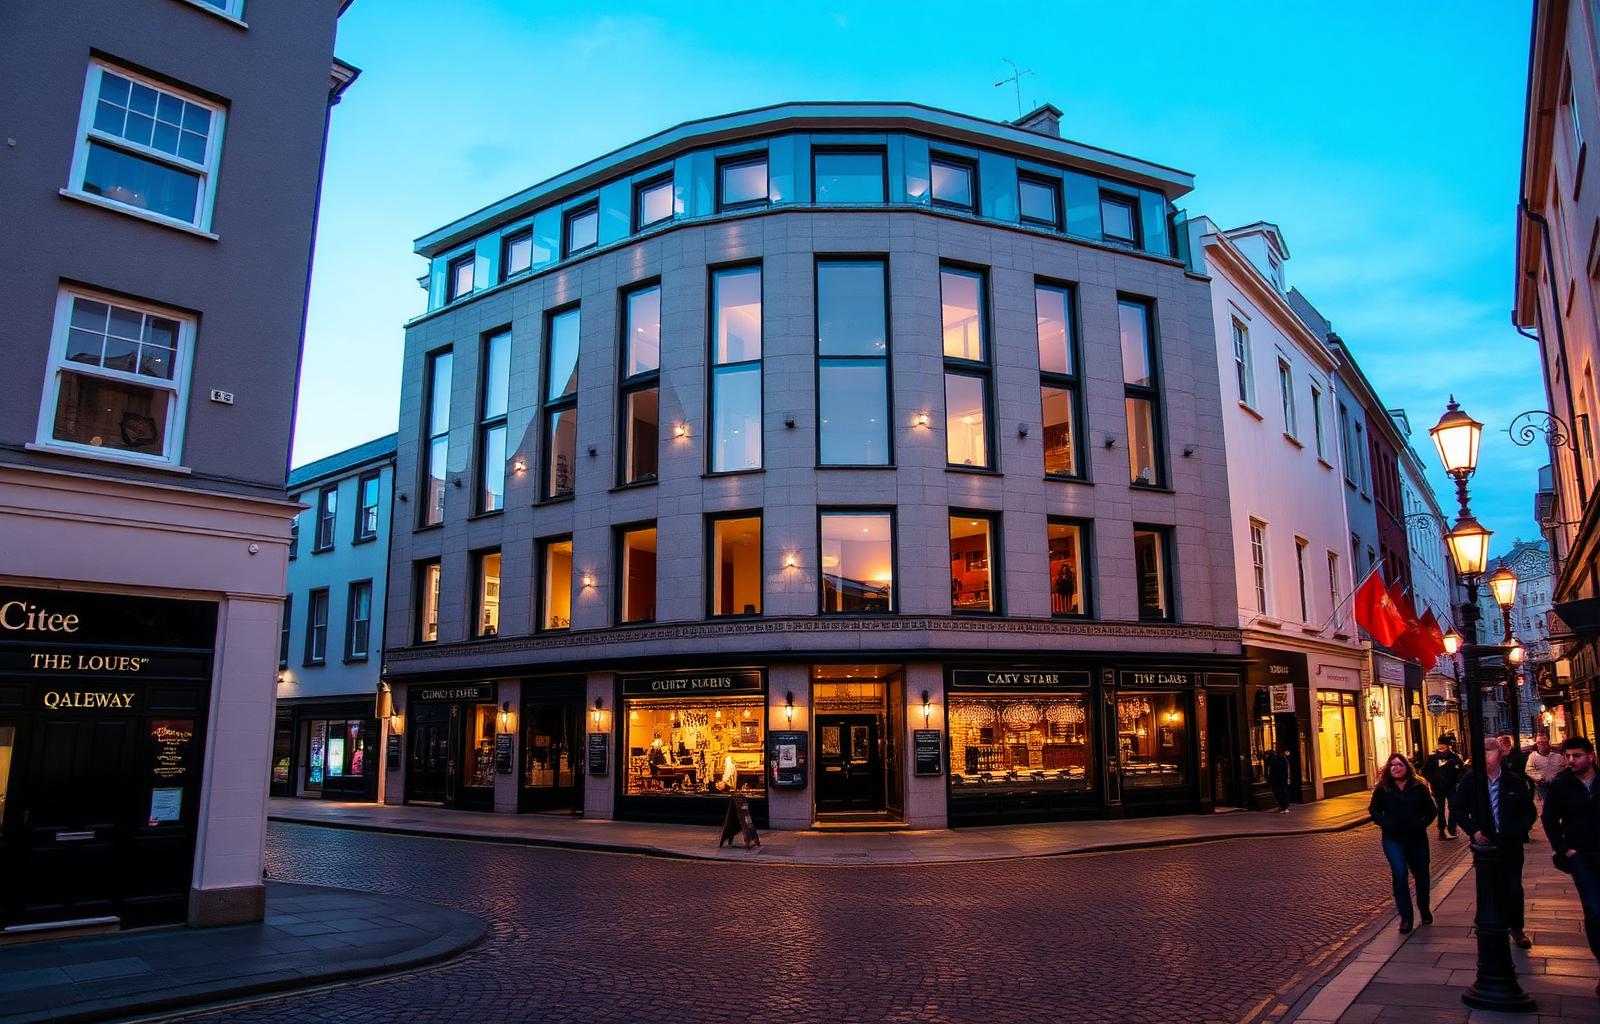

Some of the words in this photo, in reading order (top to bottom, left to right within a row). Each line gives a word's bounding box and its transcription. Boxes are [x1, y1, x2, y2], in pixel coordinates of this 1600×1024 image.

[0, 601, 79, 632] Citee
[30, 653, 72, 670] THE
[44, 691, 135, 709] QALEWAY
